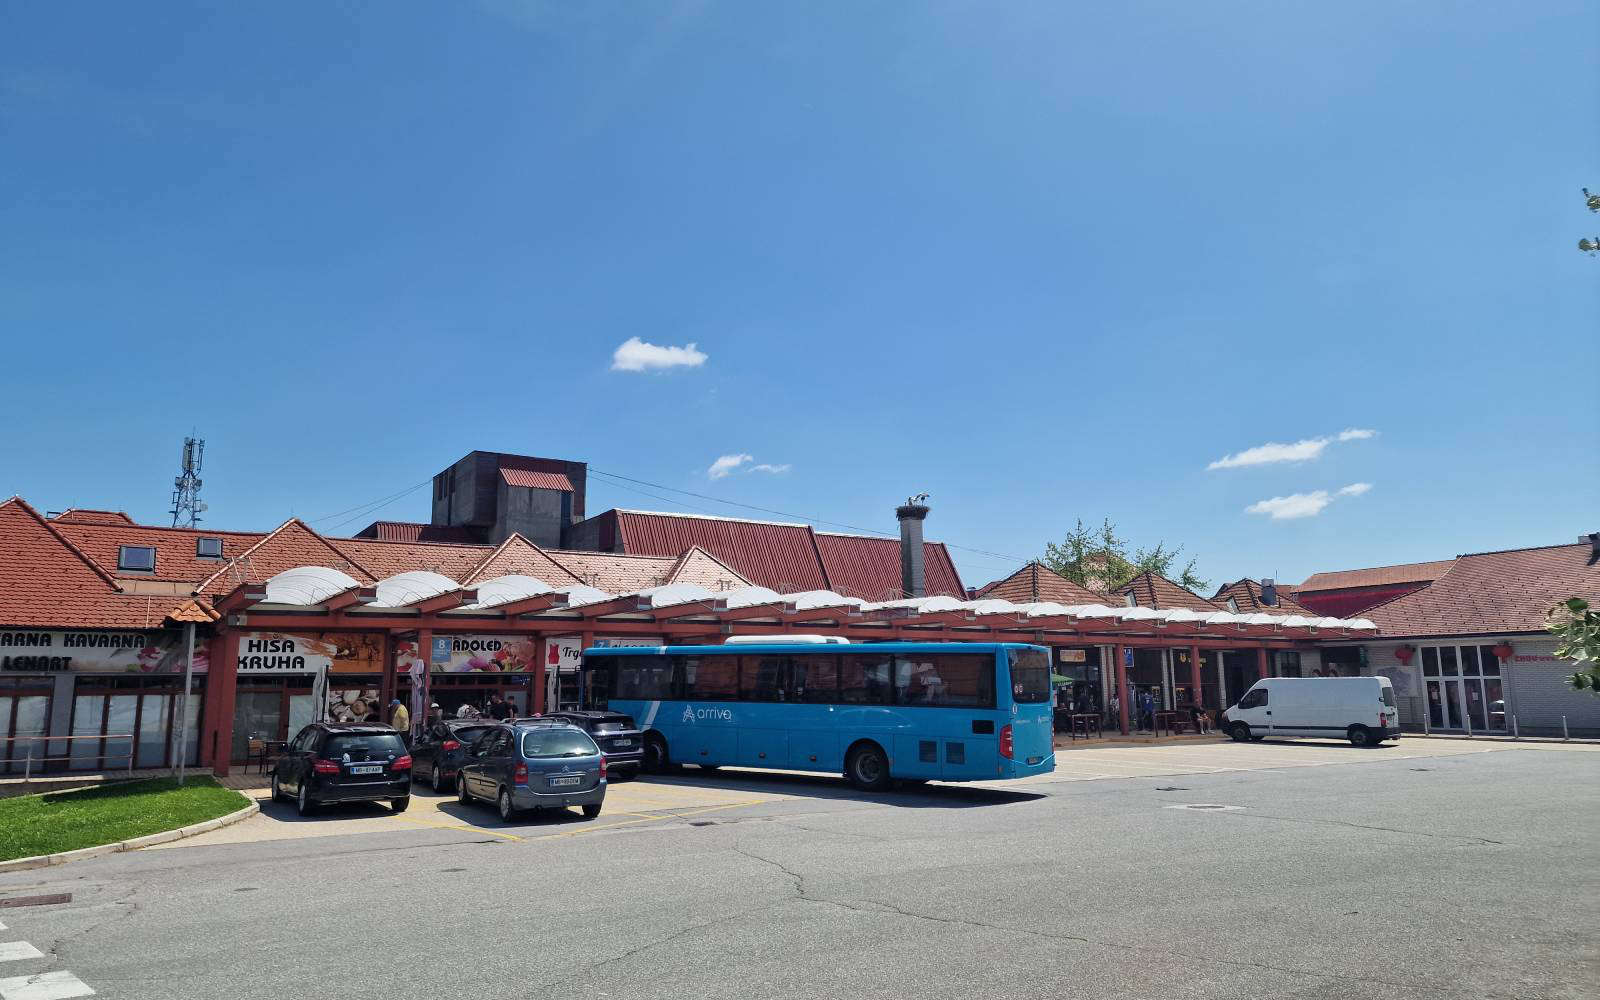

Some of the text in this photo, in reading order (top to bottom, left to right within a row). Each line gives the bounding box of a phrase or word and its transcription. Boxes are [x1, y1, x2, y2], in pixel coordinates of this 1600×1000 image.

[0, 632, 146, 648] ARNA KAVARNA
[438, 640, 446, 649] 8
[453, 640, 502, 652] ADOLED
[3, 655, 73, 671] LENART
[237, 656, 305, 669] KRUHA
[697, 706, 732, 720] arriva
